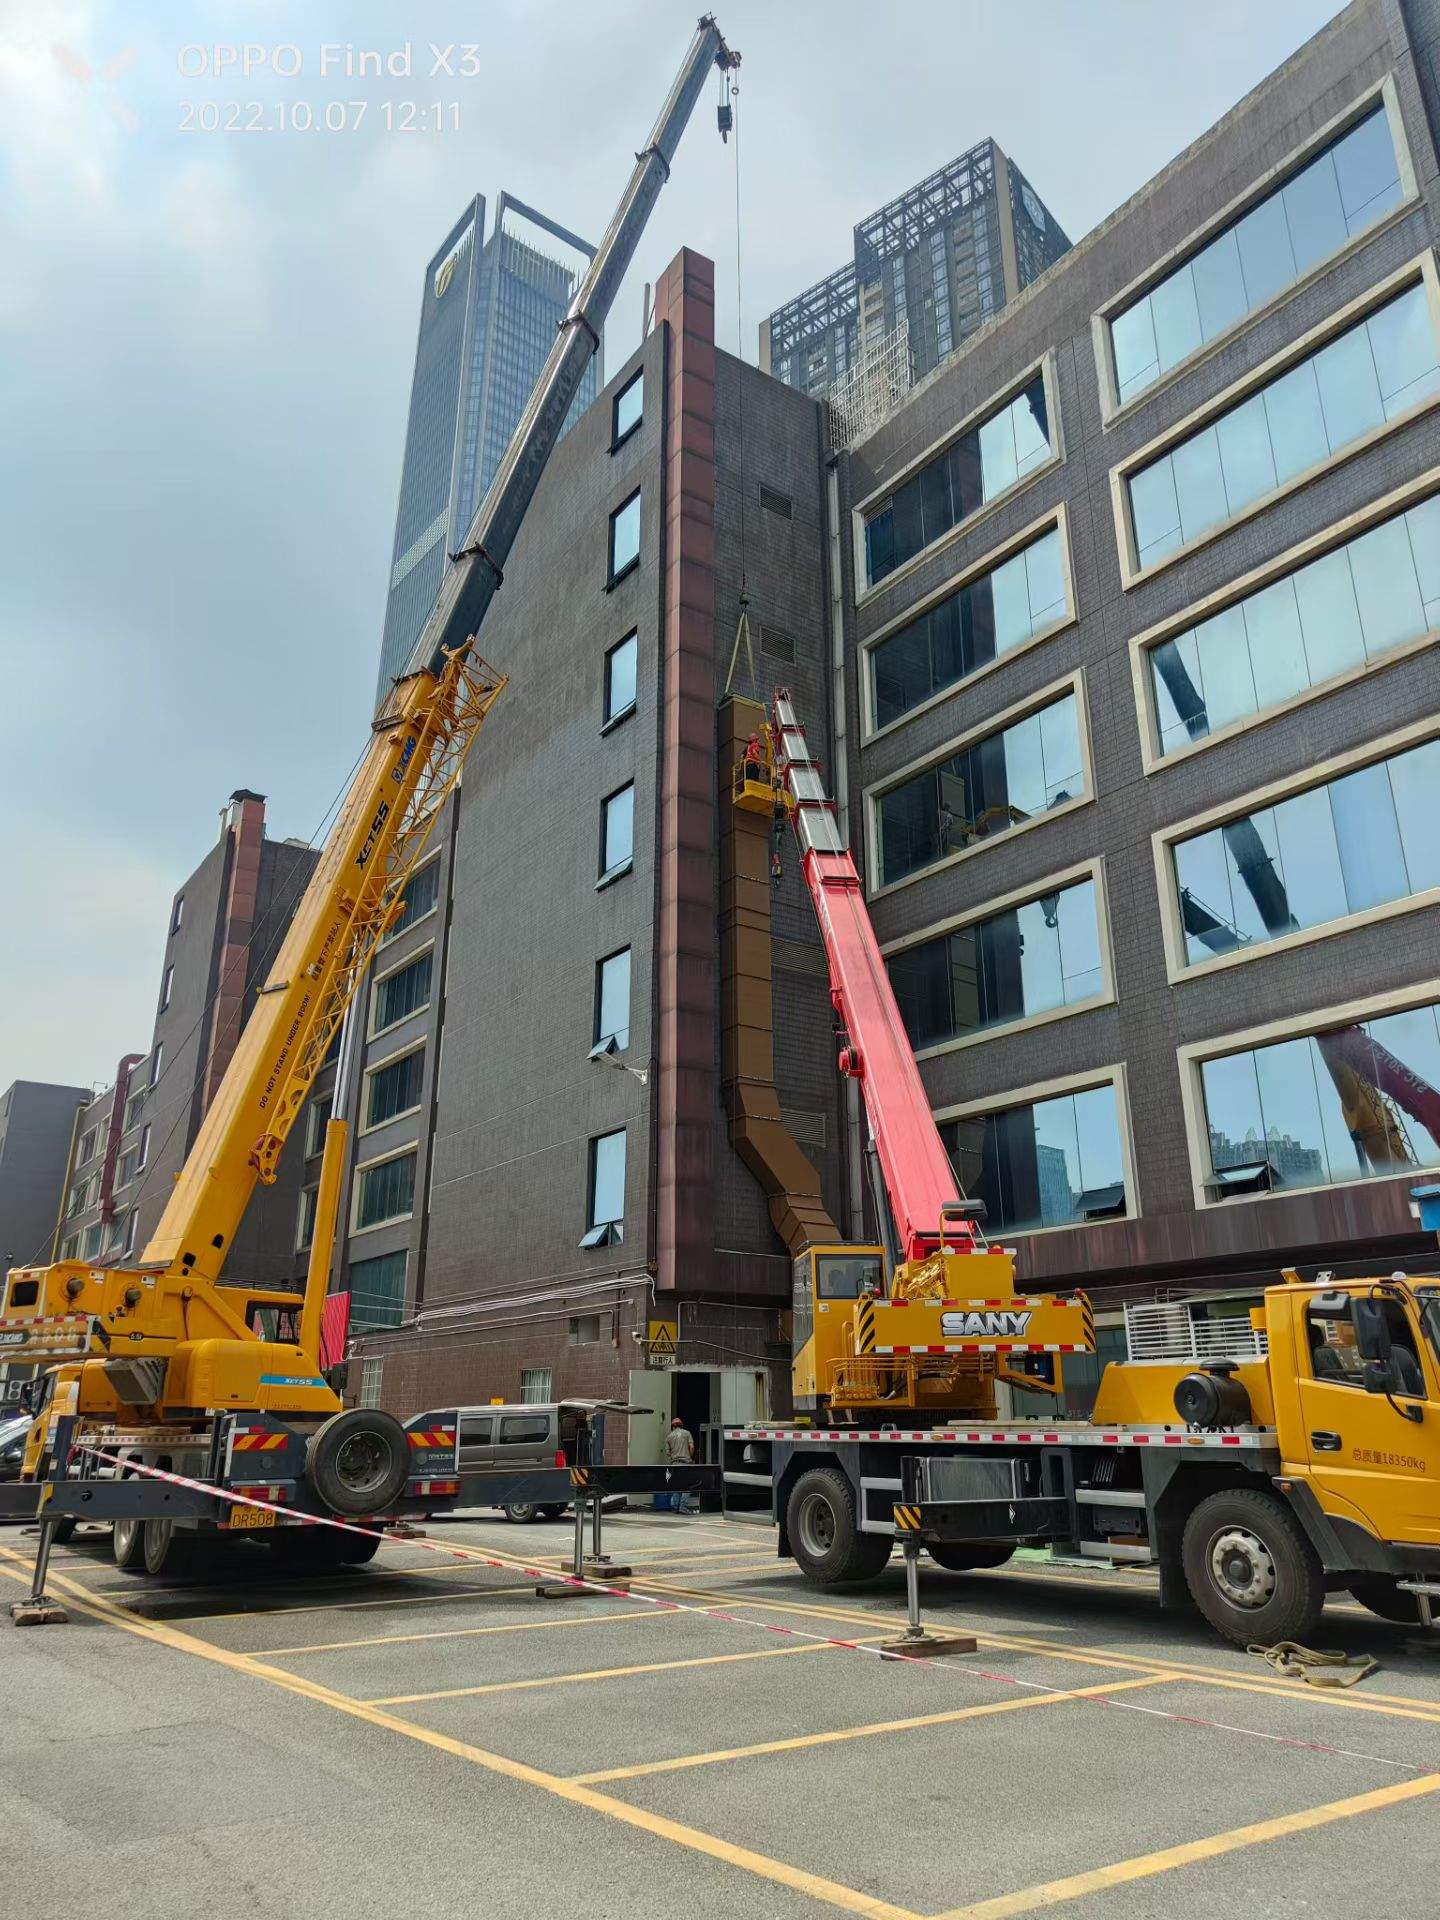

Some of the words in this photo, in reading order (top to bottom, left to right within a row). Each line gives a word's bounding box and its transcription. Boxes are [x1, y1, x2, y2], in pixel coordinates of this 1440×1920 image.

[355, 800, 390, 870] XCT55
[260, 1096, 269, 1109] DO
[266, 1077, 276, 1094] NOT
[273, 1048, 288, 1075] STAND
[286, 1020, 300, 1046] UNDER
[941, 1311, 1032, 1336] SANY
[1353, 1448, 1426, 1473] 总质量18350kg
[231, 1512, 274, 1527] DR508
